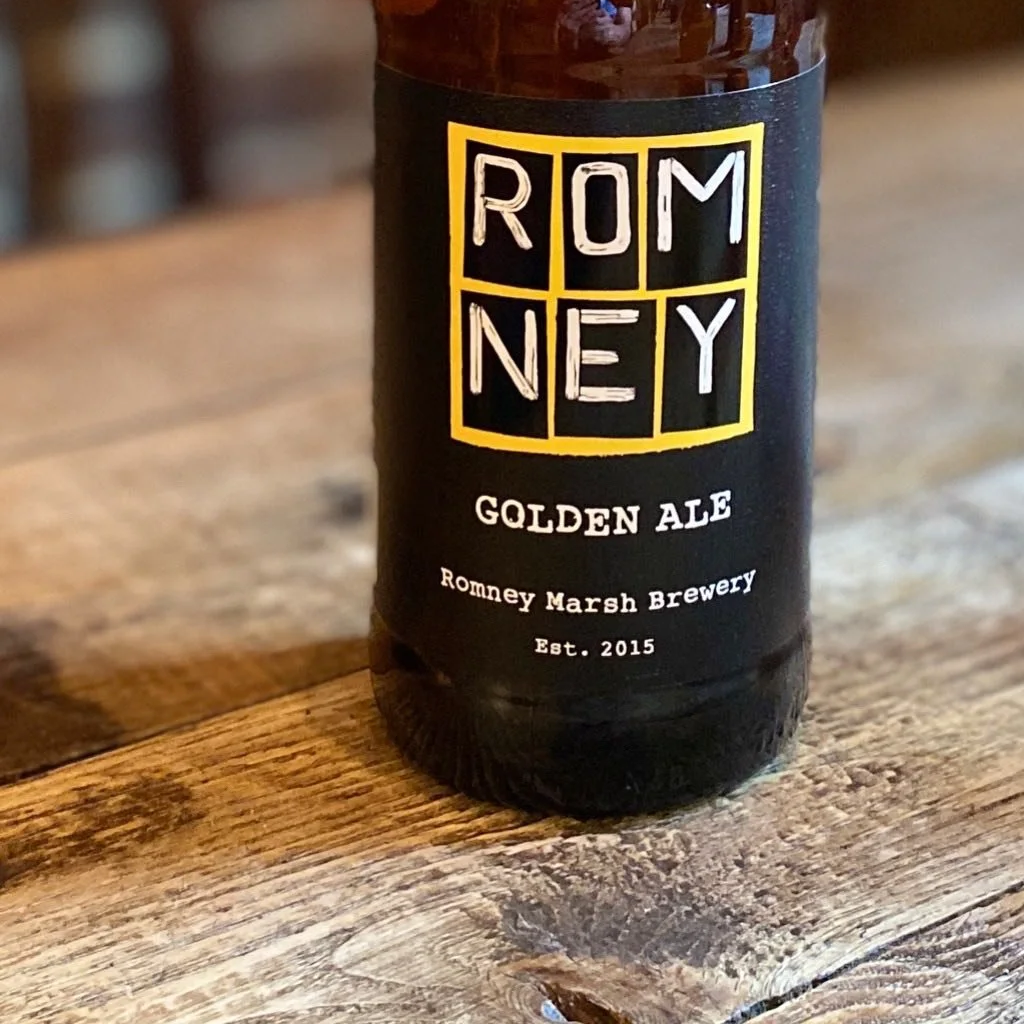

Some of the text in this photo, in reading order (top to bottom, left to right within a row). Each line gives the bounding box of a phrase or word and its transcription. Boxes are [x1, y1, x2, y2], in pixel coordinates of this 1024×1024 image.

[472, 150, 745, 256] ROM
[469, 297, 737, 403] NEY
[475, 489, 732, 537] GOLDEN ALE
[440, 567, 757, 614] Romney Marsh Brewery
[534, 637, 655, 657] Est. 2015
